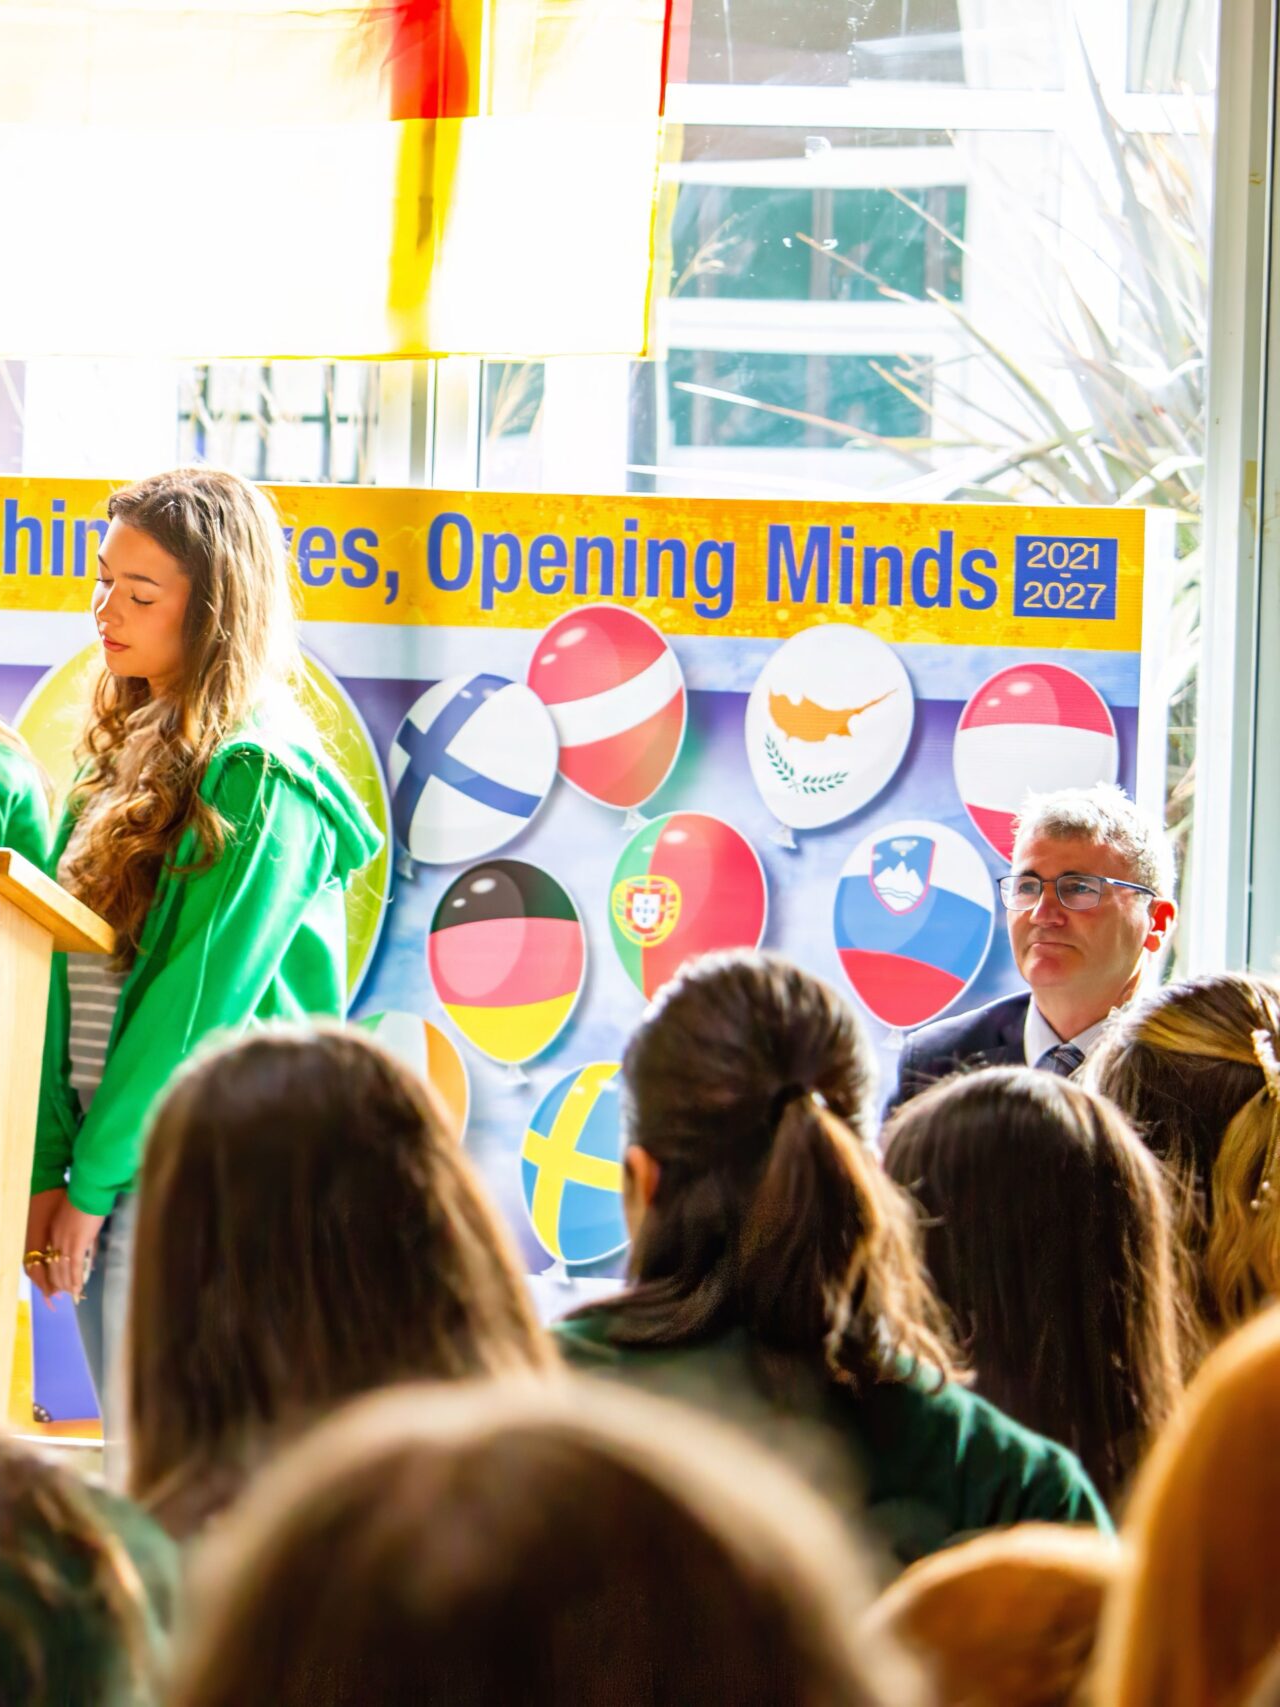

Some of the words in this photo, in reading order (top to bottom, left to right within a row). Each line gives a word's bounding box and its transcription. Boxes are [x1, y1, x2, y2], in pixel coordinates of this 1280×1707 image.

[427, 512, 735, 619] Opening
[767, 524, 998, 610] Minds
[1026, 541, 1100, 570] 2021
[1022, 581, 1107, 610] 2027
